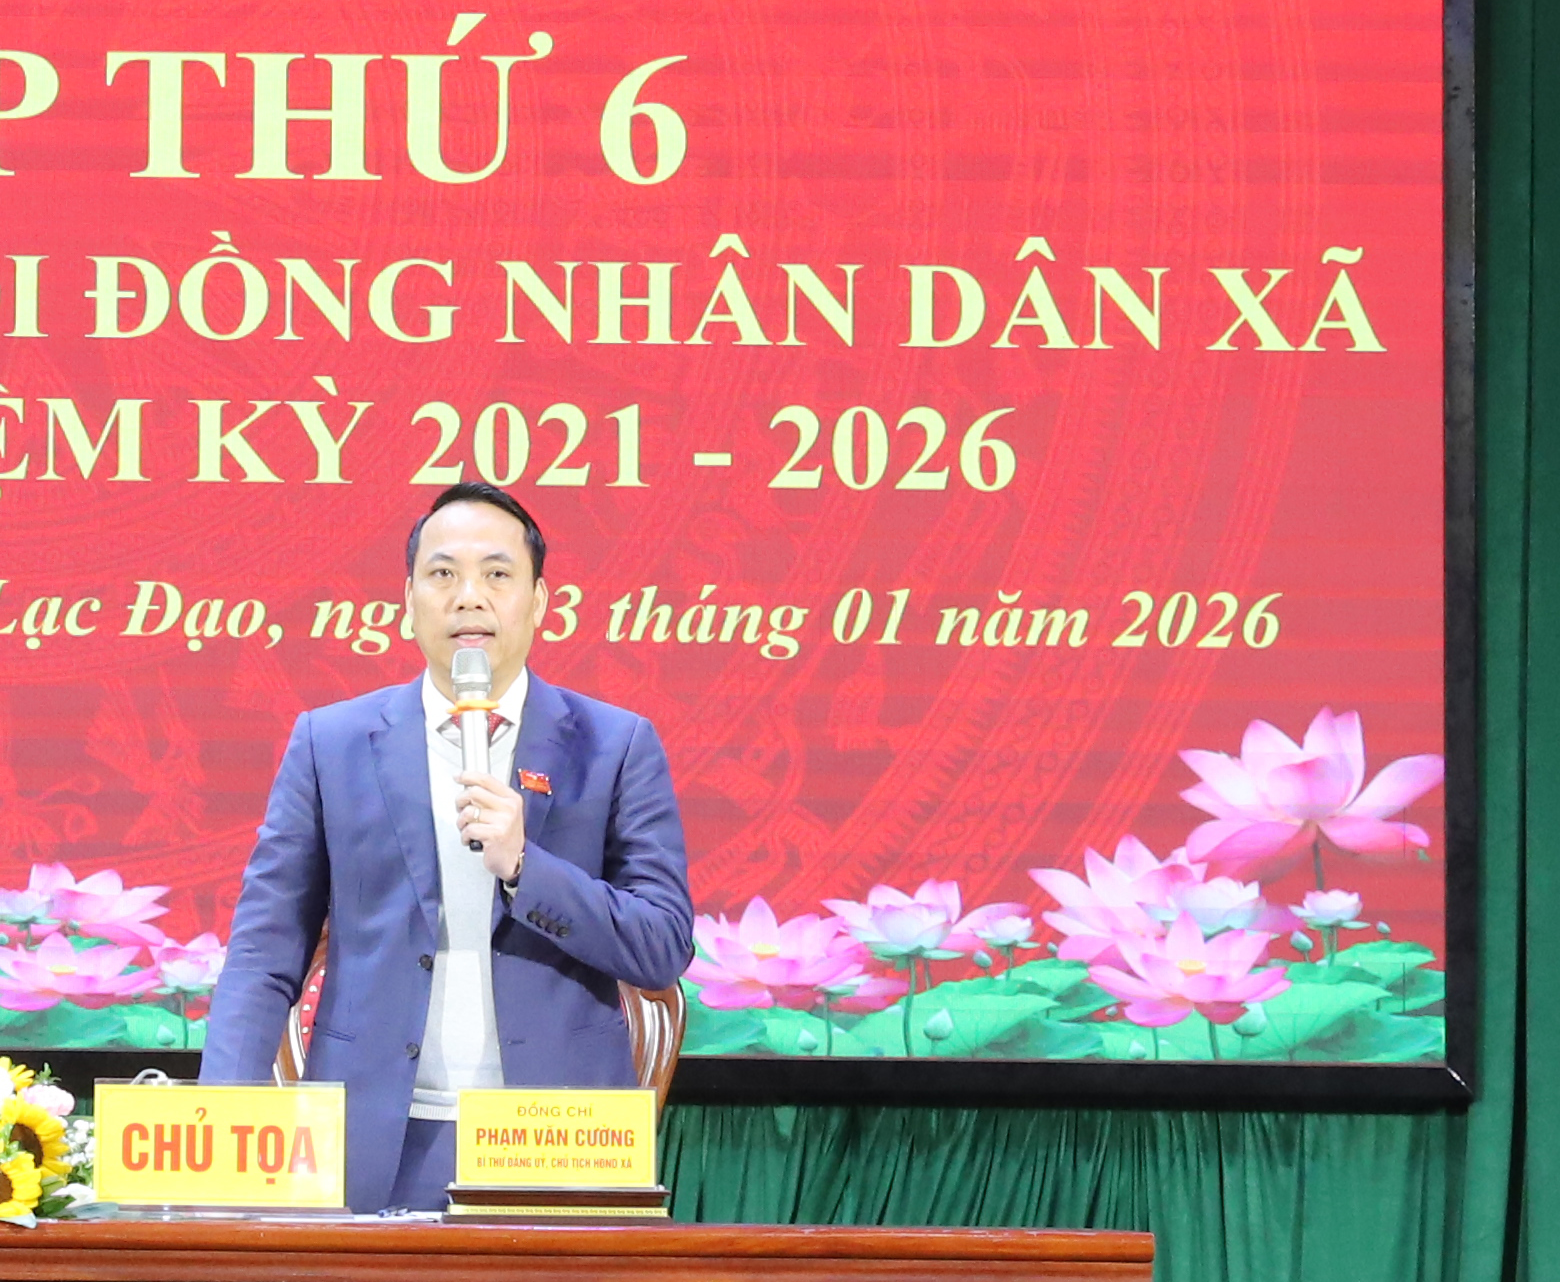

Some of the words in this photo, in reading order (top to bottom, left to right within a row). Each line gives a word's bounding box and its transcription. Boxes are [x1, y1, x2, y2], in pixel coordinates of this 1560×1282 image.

[106, 12, 554, 184] THỨ
[599, 55, 688, 185] 6
[84, 230, 460, 343] ĐỒNG
[495, 233, 863, 347] NHÂN
[899, 236, 1170, 351] DÂN
[1205, 246, 1388, 352] XÃ
[187, 375, 375, 484] KỲ
[409, 401, 650, 487] 2021
[693, 452, 732, 466] -
[767, 404, 1016, 492] 2026
[120, 580, 283, 652] Đạo,
[309, 600, 416, 656] ng
[541, 584, 583, 643] 3
[605, 584, 810, 660] tháng
[832, 587, 911, 645] 01
[935, 589, 1089, 648] năm
[1111, 590, 1283, 649] 2026
[121, 1107, 214, 1173] CHỦ
[230, 1124, 318, 1185] TỌA
[475, 1128, 528, 1151] PHẠM
[533, 1125, 569, 1147] VĂN
[575, 1125, 636, 1147] CƯỜNG
[566, 1103, 593, 1117] CHÍ
